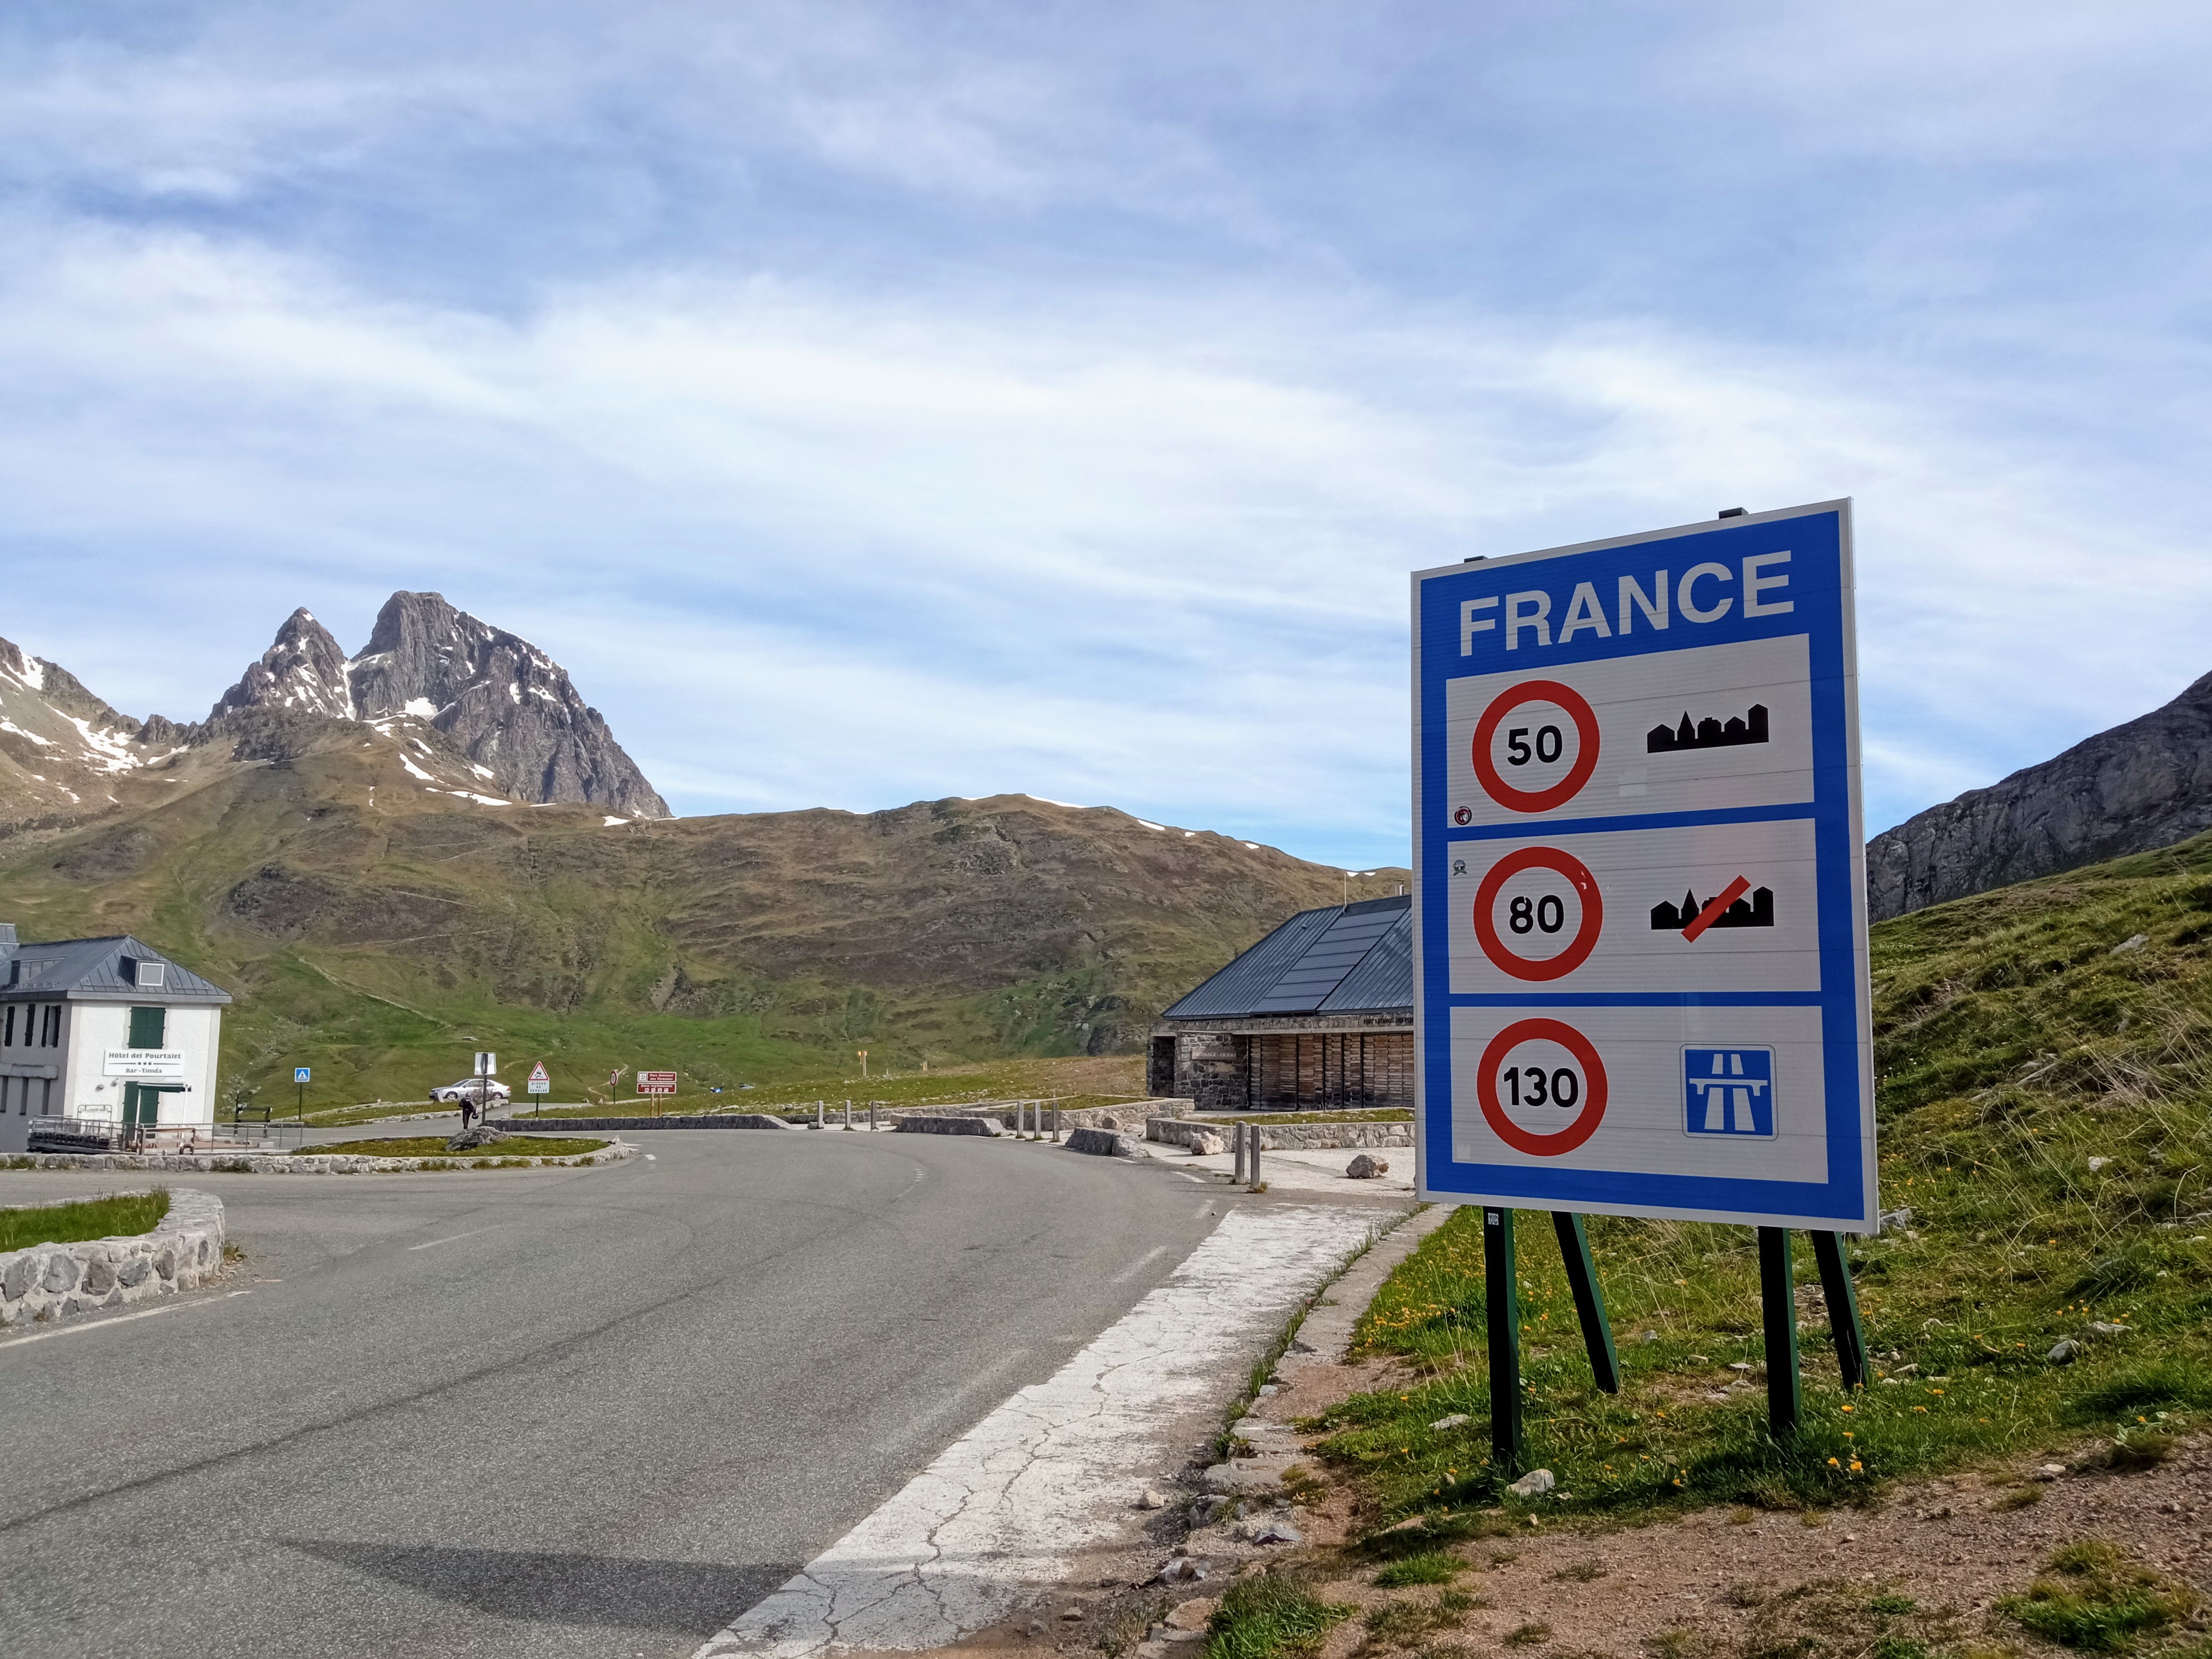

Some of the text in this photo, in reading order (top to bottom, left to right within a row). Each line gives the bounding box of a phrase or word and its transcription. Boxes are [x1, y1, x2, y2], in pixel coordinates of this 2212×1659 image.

[1460, 551, 1794, 657] FRANCE
[1507, 725, 1563, 766] 50
[1509, 895, 1564, 934] 80
[1504, 1067, 1579, 1107] 130
